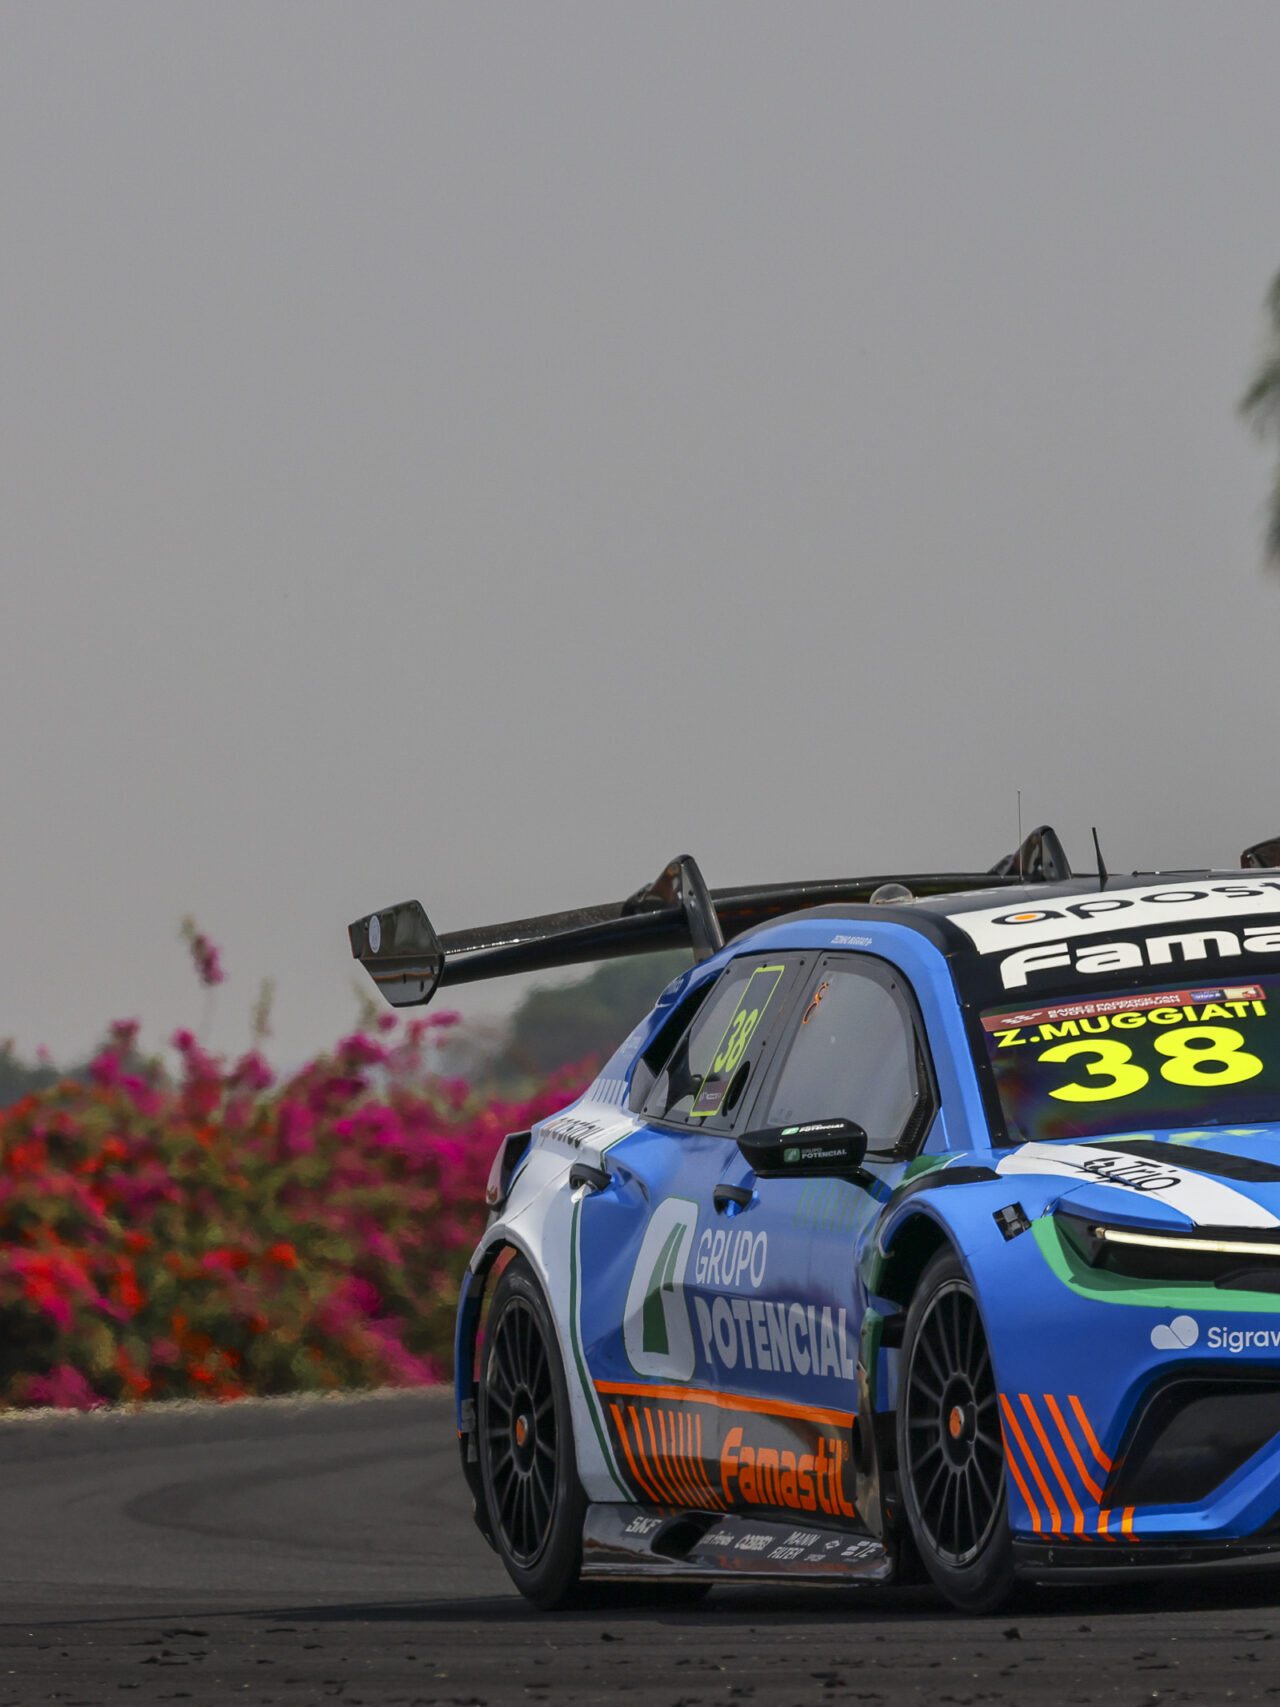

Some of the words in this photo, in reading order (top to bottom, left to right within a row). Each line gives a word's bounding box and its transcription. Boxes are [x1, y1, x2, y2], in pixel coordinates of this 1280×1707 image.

[714, 1009, 758, 1073] 38
[993, 1000, 1267, 1047] Z.MUGGIATI
[1037, 1026, 1264, 1102] 38
[696, 1228, 768, 1288] GRUPO
[694, 1296, 854, 1380] POTENCIAL
[625, 1516, 662, 1534] SKF
[784, 1531, 821, 1547] MANN
[767, 1547, 804, 1560] FILTER
